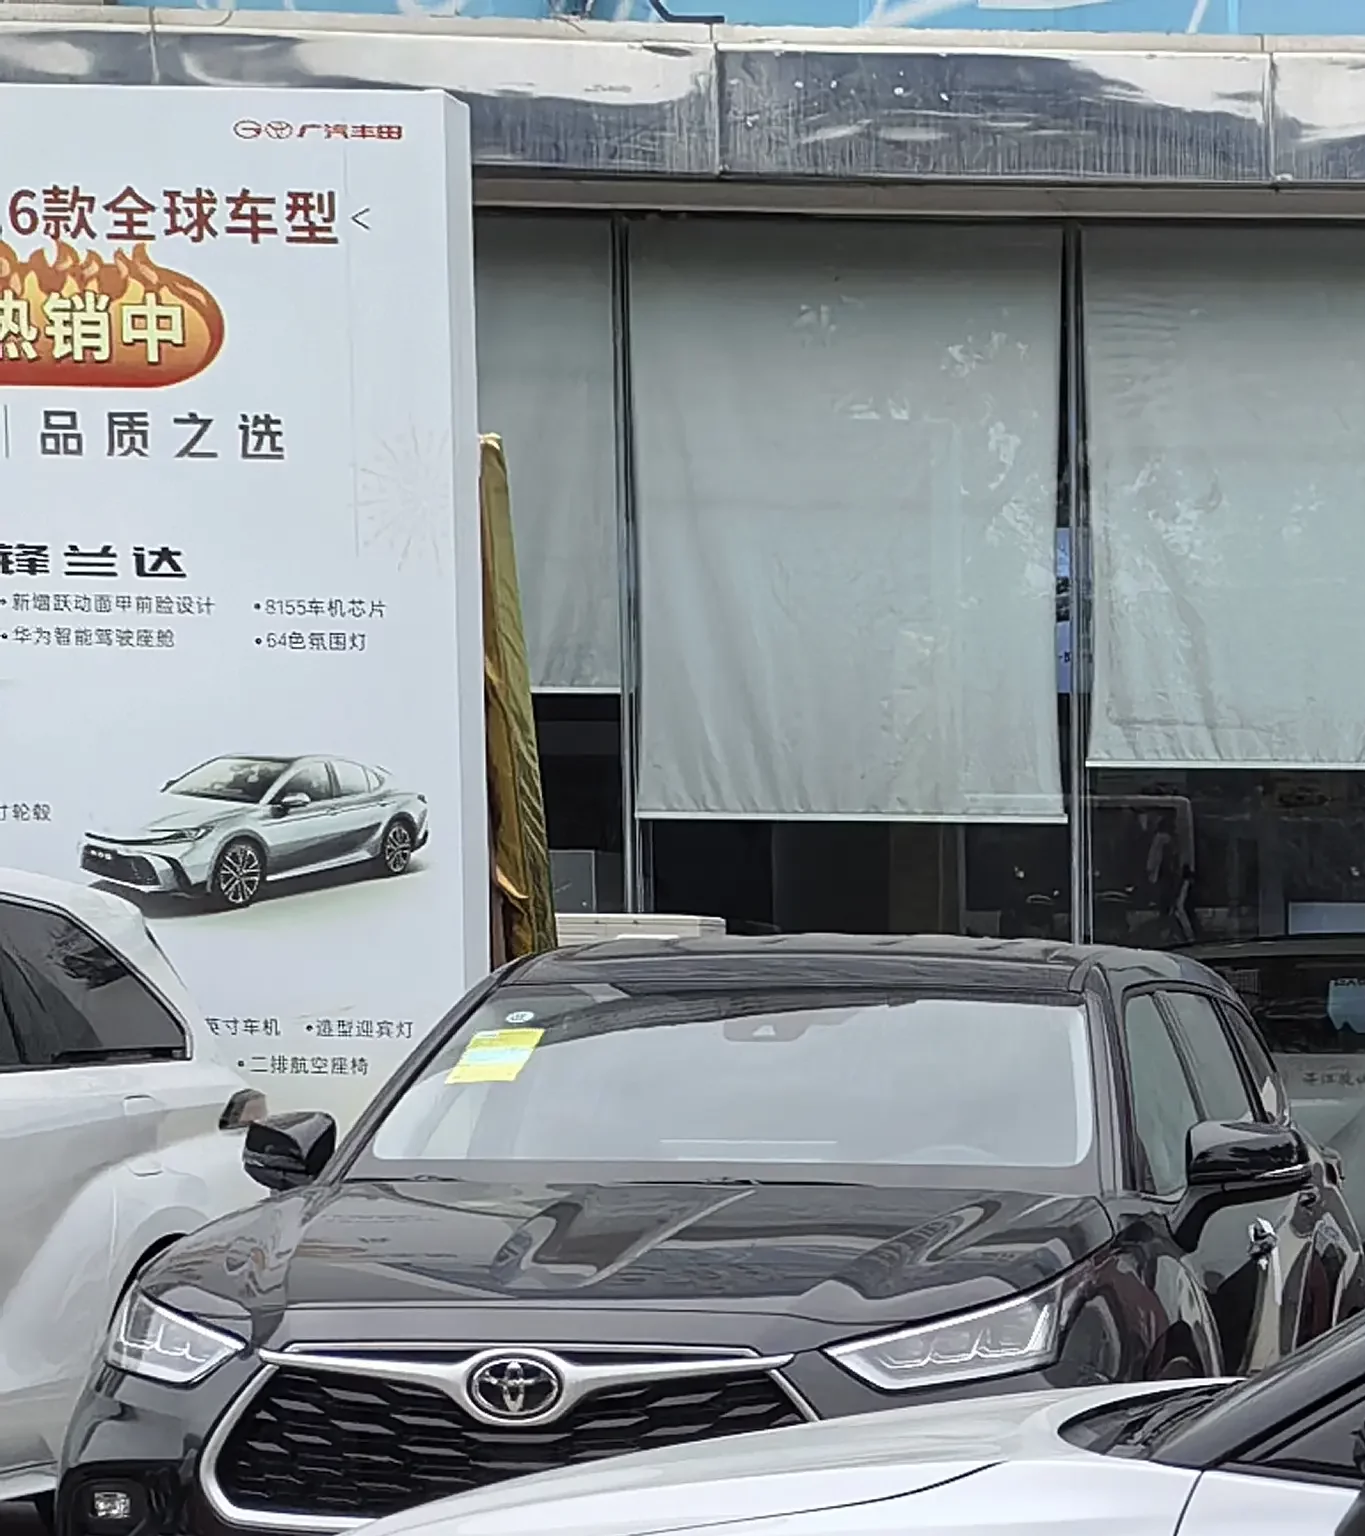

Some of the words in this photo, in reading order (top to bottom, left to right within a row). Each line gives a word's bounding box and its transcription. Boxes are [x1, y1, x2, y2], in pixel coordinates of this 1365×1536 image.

[297, 123, 403, 140] 广汽丰田
[0, 184, 339, 245] 6款全球车型
[0, 288, 187, 366] 热销中
[40, 410, 286, 461] 品质之选
[0, 543, 188, 578] 锋兰达
[12, 592, 216, 616] 新增跃动面甲前脸设计
[265, 598, 387, 618] 8155车机芯片
[13, 626, 176, 649] 华为智能驾驶座舱
[266, 631, 366, 651] 64色氛围灯
[316, 1018, 414, 1039] 造型迎宾灯
[251, 1055, 369, 1076] 二排航空座椅
